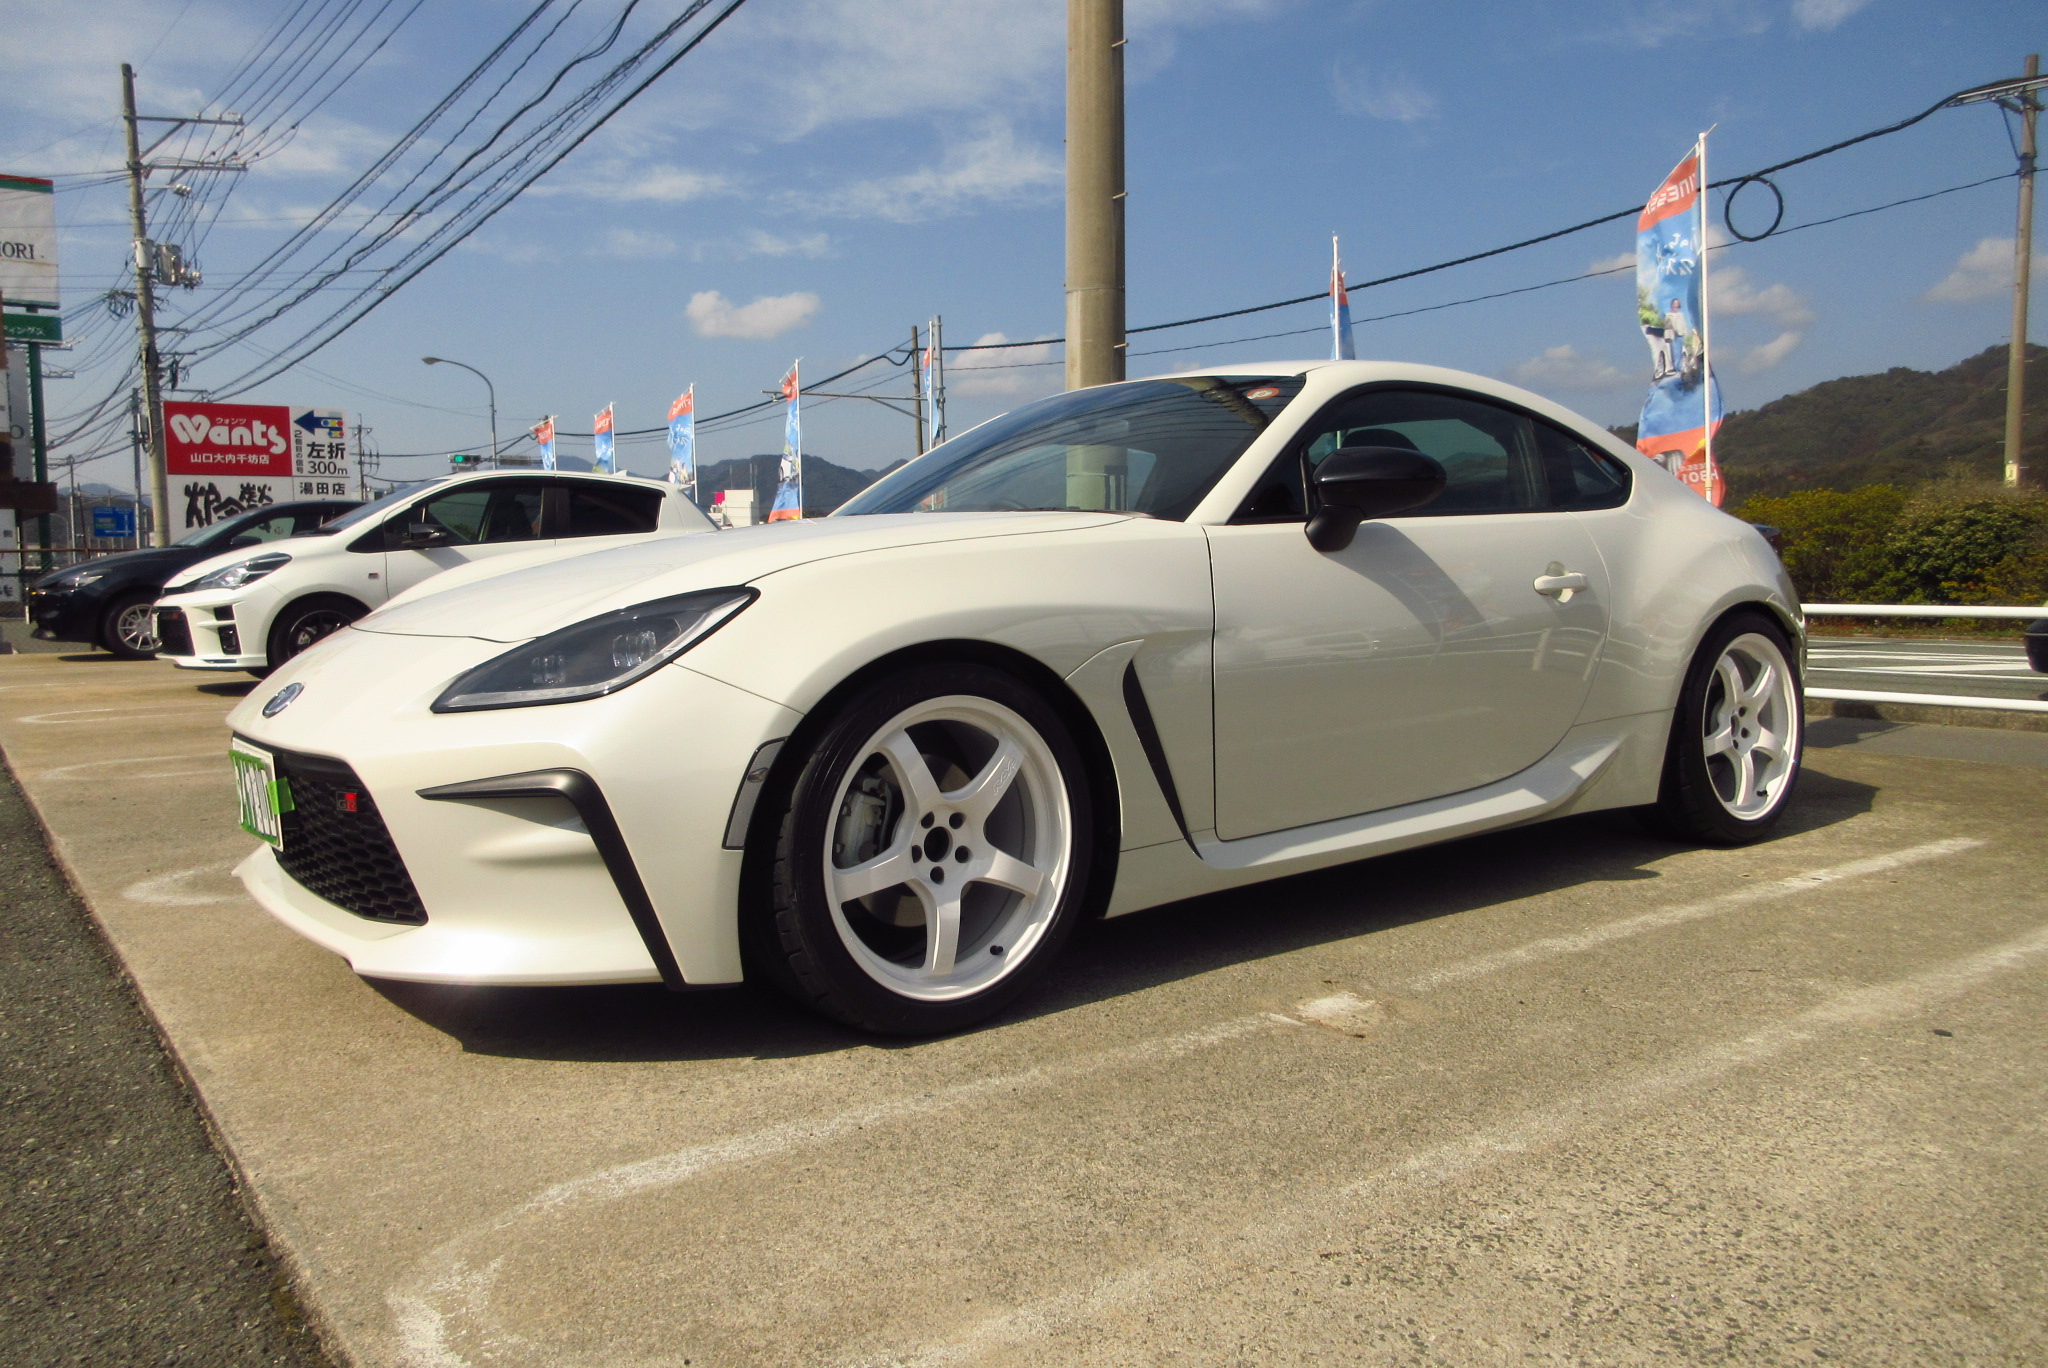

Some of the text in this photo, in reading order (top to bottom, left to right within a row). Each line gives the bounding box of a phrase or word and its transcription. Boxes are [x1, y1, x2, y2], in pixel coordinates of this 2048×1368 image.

[0, 241, 35, 260] ORI
[216, 417, 247, 425] ウォンツ
[170, 414, 287, 455] Wants
[307, 442, 346, 460] 左折
[307, 460, 348, 475] 300m
[300, 482, 346, 496] 湯田店
